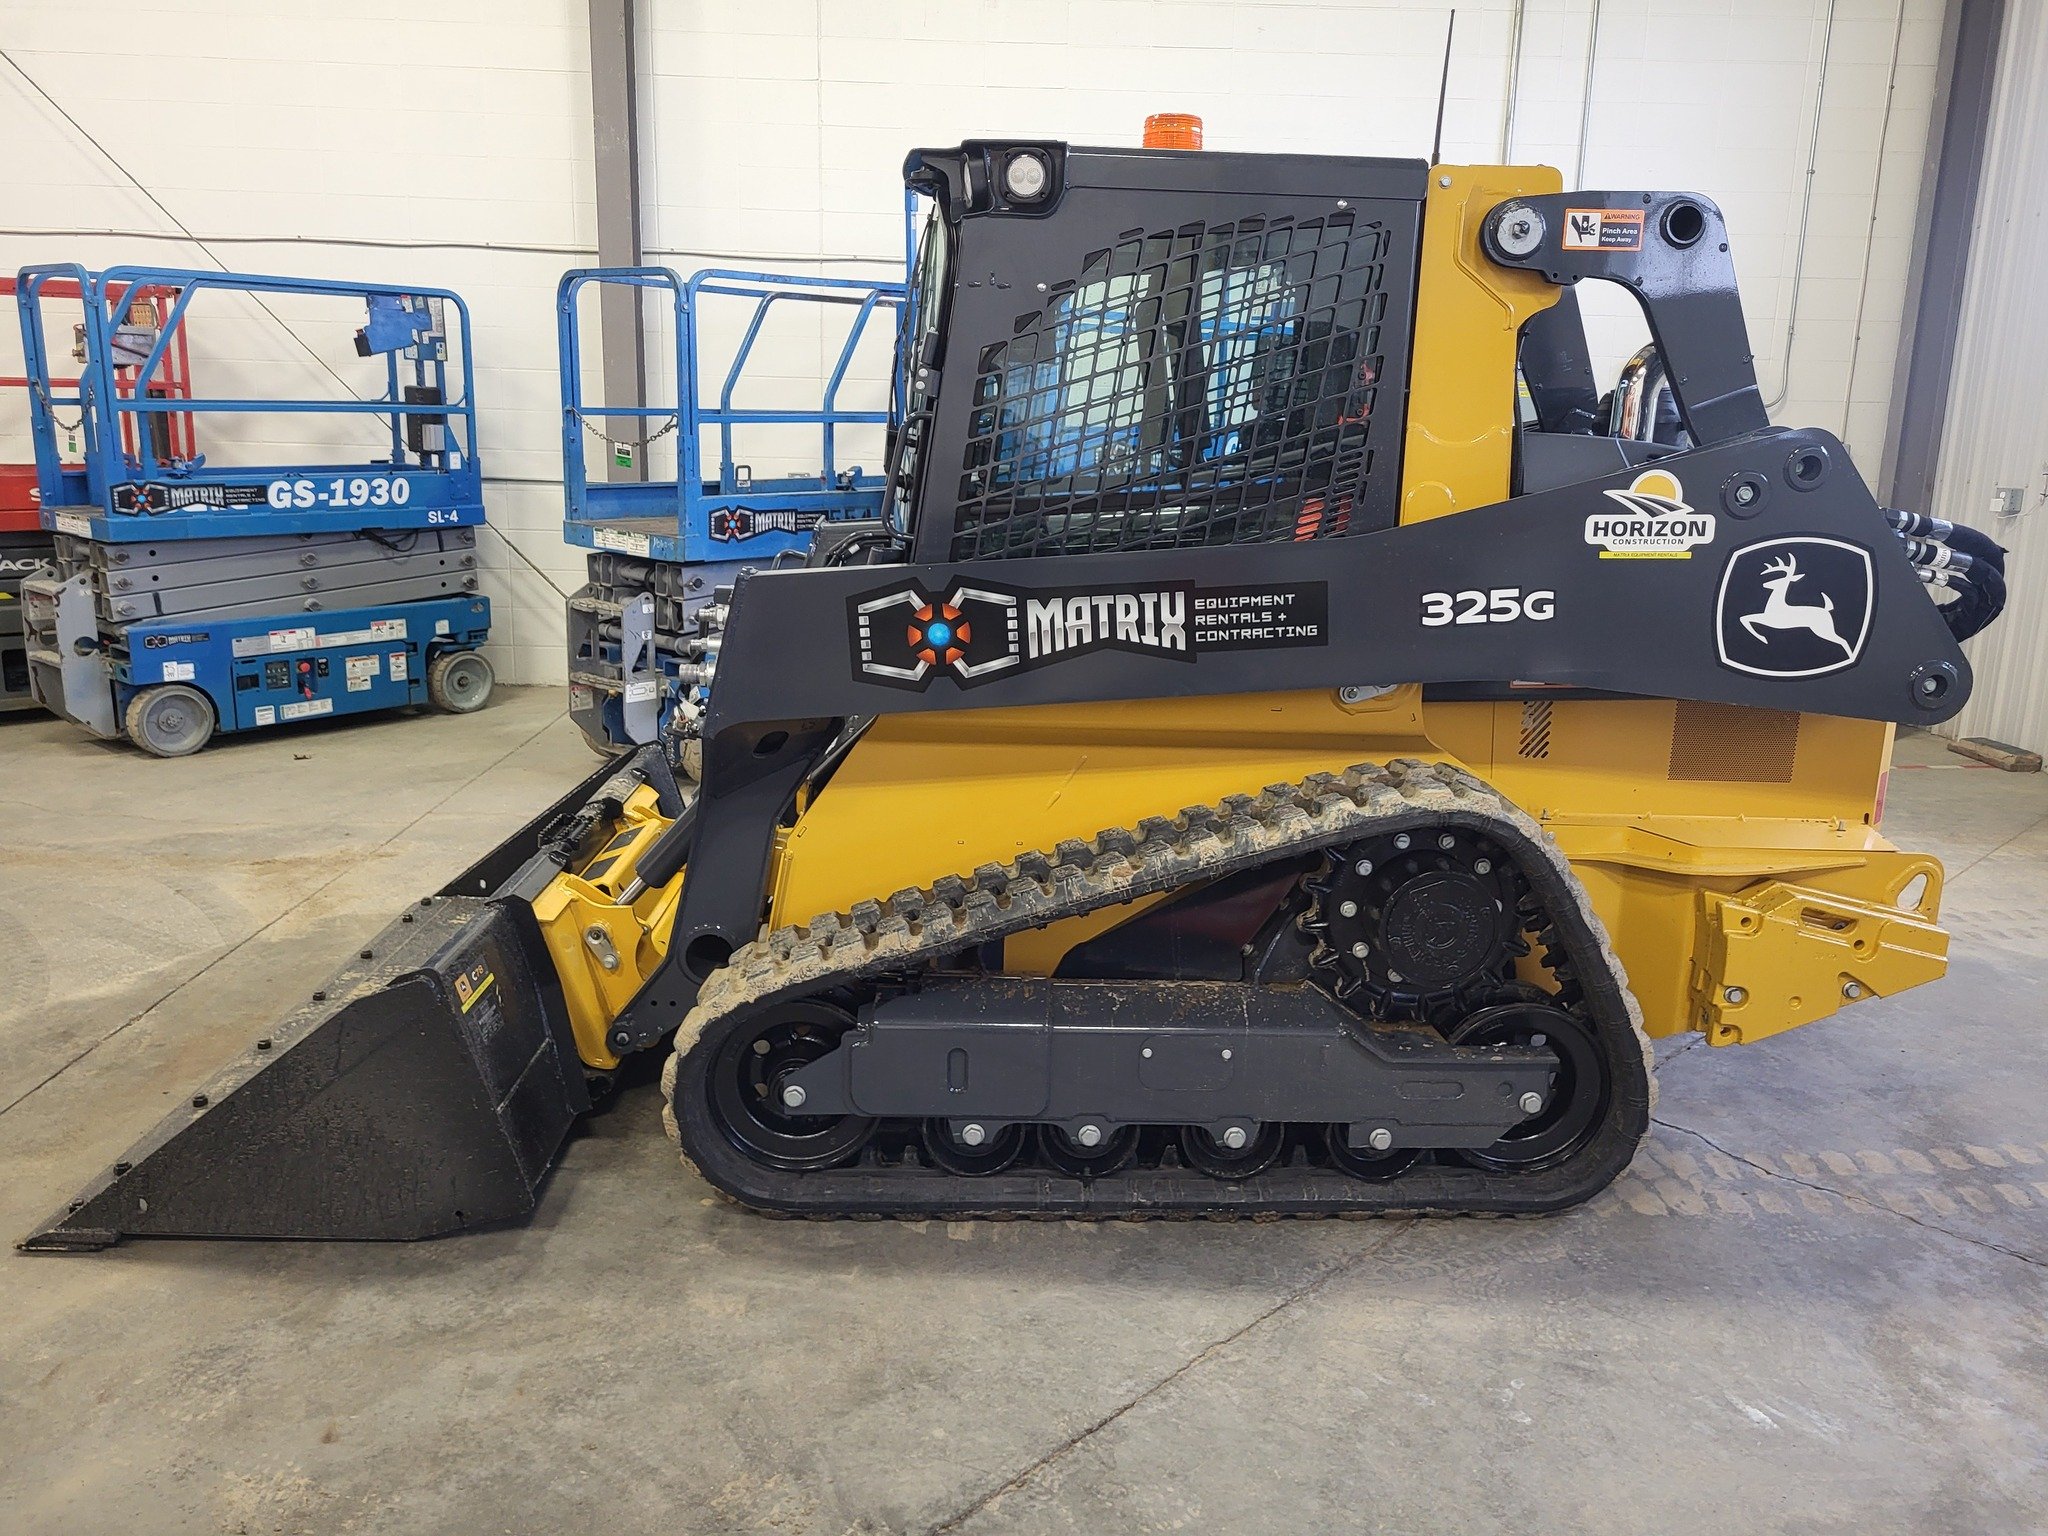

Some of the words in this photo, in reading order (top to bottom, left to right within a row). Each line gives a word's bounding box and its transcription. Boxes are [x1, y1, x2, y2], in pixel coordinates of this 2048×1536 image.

[170, 486, 225, 508] MATRIX
[267, 477, 410, 509] GS-1930
[428, 509, 459, 524] SL-4
[755, 511, 796, 534] MATRIX
[1592, 520, 1707, 537] HORIZON
[0, 556, 50, 571] ACK
[1194, 593, 1296, 610] EQUIPMENT
[1422, 588, 1555, 627] 325G
[1026, 591, 1186, 659] MATRIX
[1194, 611, 1272, 626] RENTALS
[1194, 625, 1318, 642] CONTRACTING
